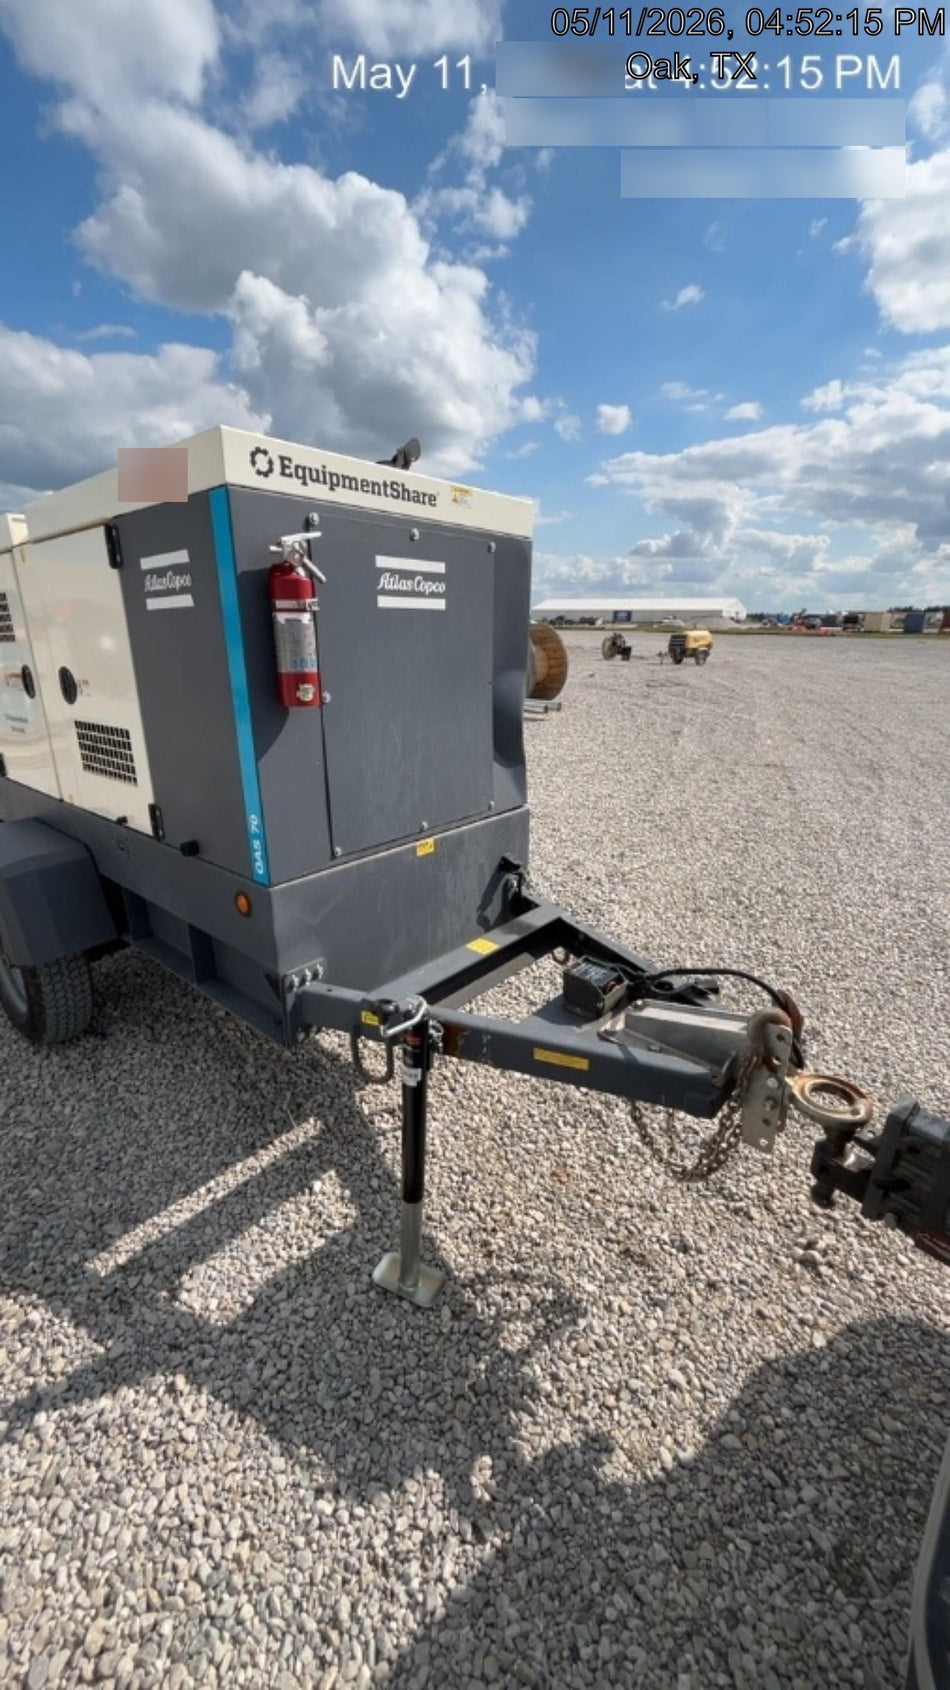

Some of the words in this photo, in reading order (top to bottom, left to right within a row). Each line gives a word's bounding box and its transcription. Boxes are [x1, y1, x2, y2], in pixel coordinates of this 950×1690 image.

[278, 455, 438, 508] EquipmentShare
[376, 572, 414, 593] Atlas
[414, 575, 446, 596] Copco
[249, 813, 261, 835] 70
